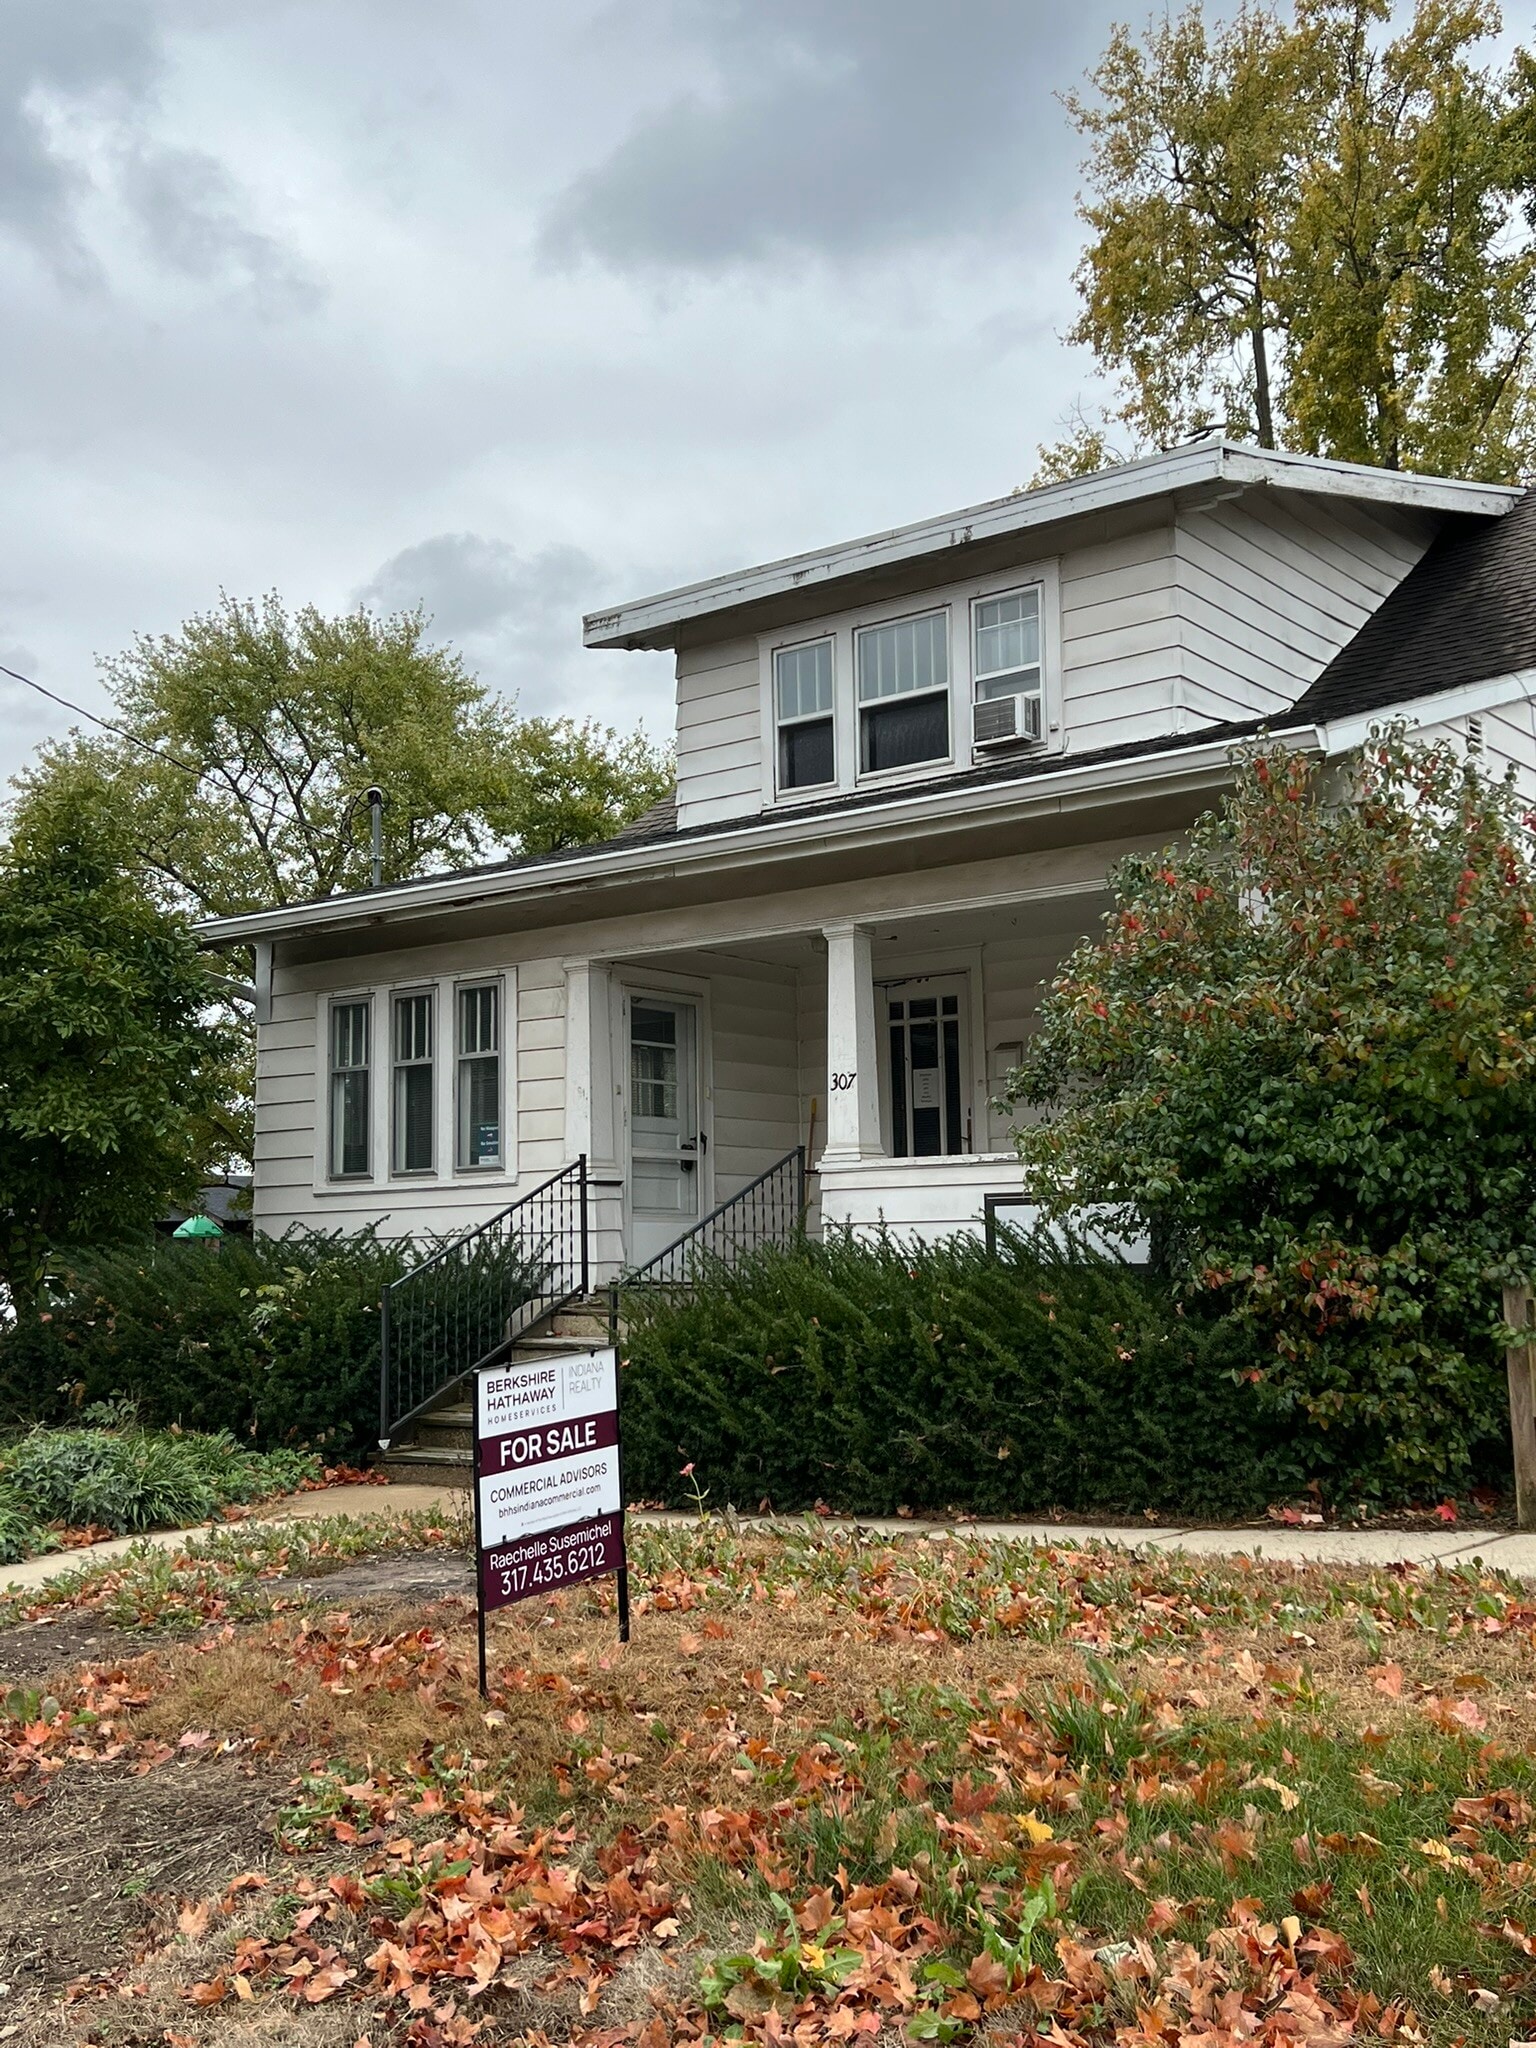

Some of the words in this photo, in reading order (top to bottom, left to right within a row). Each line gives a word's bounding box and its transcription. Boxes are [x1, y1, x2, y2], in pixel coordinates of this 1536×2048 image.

[830, 1072, 857, 1091] 307
[487, 1369, 556, 1394] BERKSHIRE
[568, 1361, 605, 1379] INDIANA
[569, 1377, 602, 1394] REALTY
[487, 1386, 556, 1411] HATHAWAY
[487, 1404, 557, 1425] HOMESERVICES
[500, 1434, 543, 1467] FOR
[546, 1421, 597, 1455] SALE
[490, 1474, 558, 1503] COMMERCIAL
[560, 1462, 608, 1485] ADVISORS
[498, 1484, 601, 1518] bhhsindianacommercial.com
[490, 1541, 548, 1570] Raechelle
[549, 1520, 612, 1553] Susemichel
[501, 1542, 606, 1596] 317.435.6212
